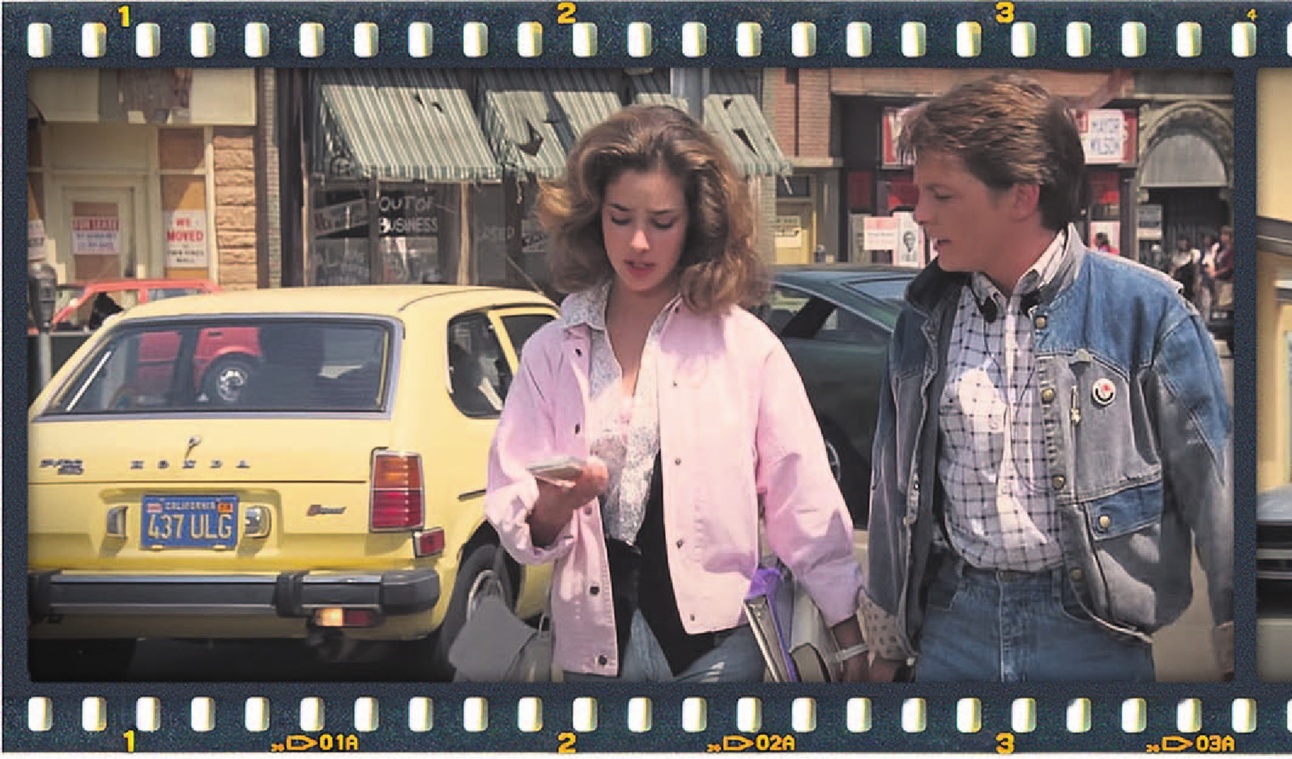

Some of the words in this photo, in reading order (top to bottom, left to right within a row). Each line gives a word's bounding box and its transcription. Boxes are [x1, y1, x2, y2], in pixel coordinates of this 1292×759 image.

[379, 195, 412, 212] OUT
[378, 217, 438, 234] BUSINESS
[166, 230, 204, 243] MOVED
[164, 500, 216, 511] CALIFORNIA
[146, 514, 185, 540] 437
[190, 513, 233, 540] ULG
